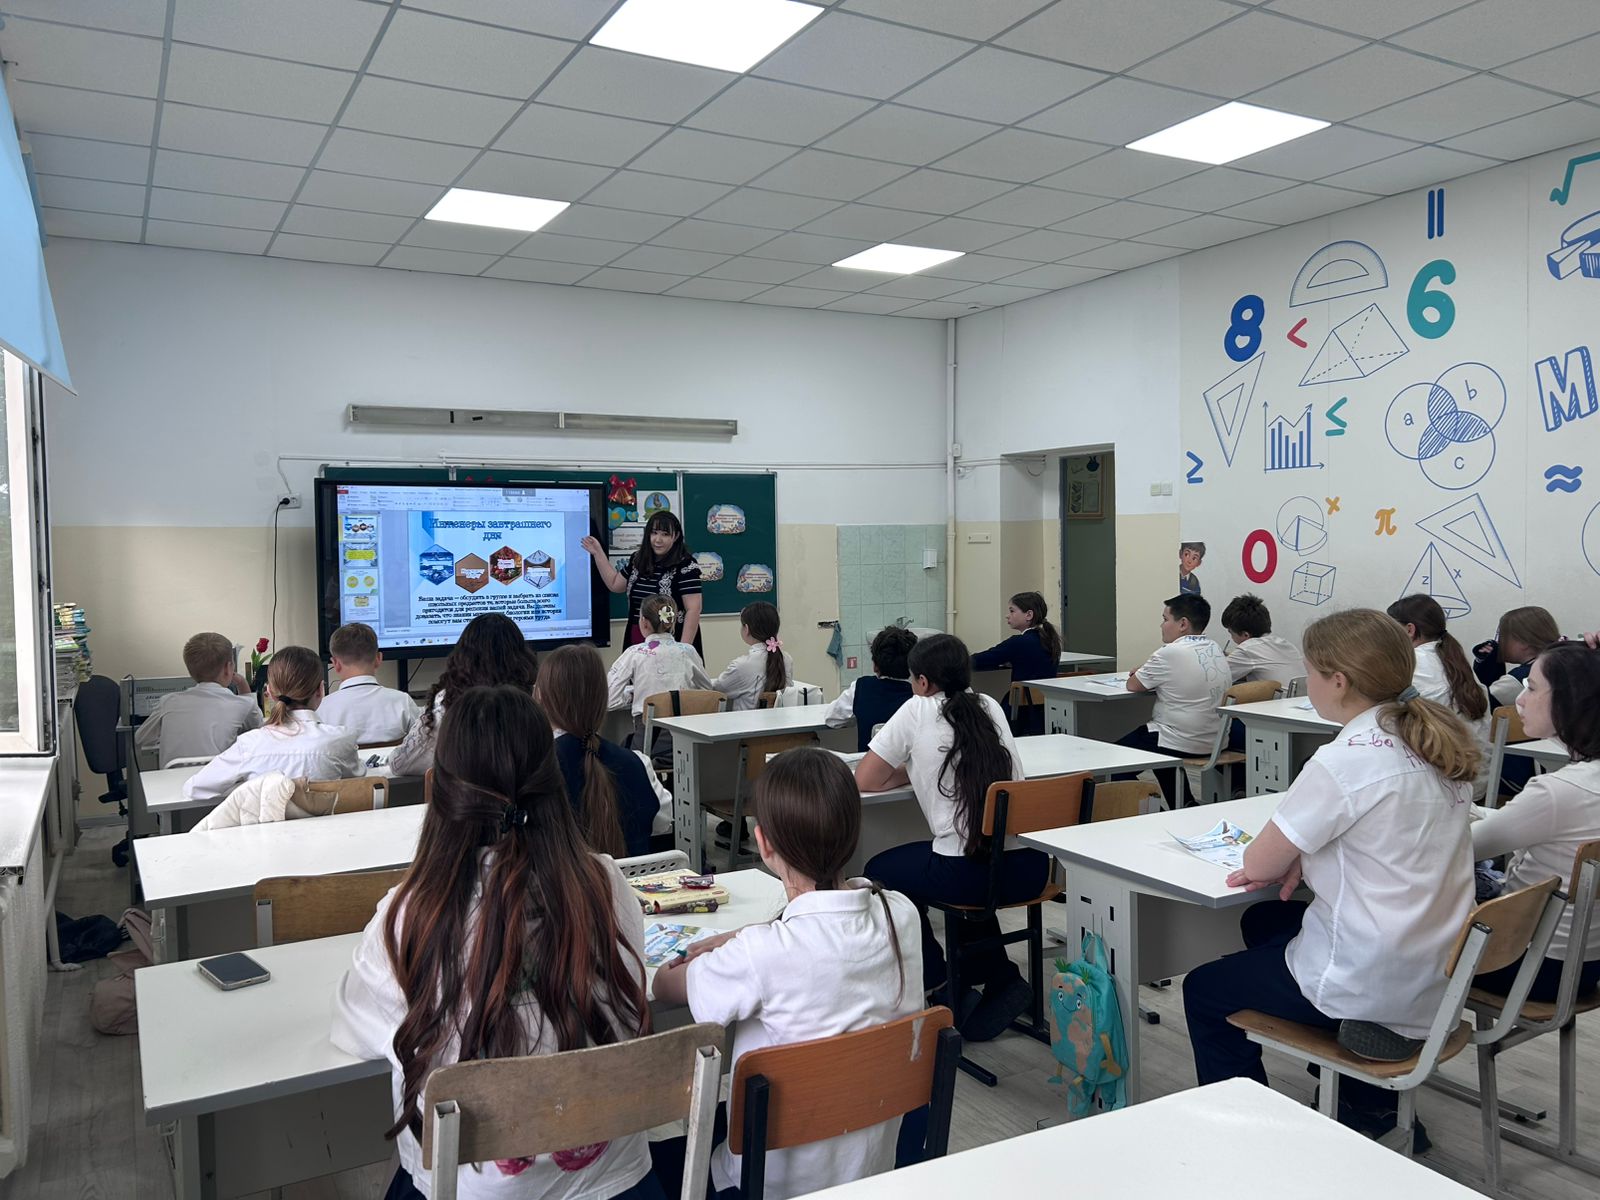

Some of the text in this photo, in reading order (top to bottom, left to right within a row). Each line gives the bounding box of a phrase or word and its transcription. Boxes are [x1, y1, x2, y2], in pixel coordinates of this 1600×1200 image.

[1407, 259, 1456, 339] 6
[1224, 294, 1265, 362] 8
[1465, 379, 1478, 400] b
[1403, 412, 1415, 427] a
[429, 518, 552, 530] Инженеры завтрашнего
